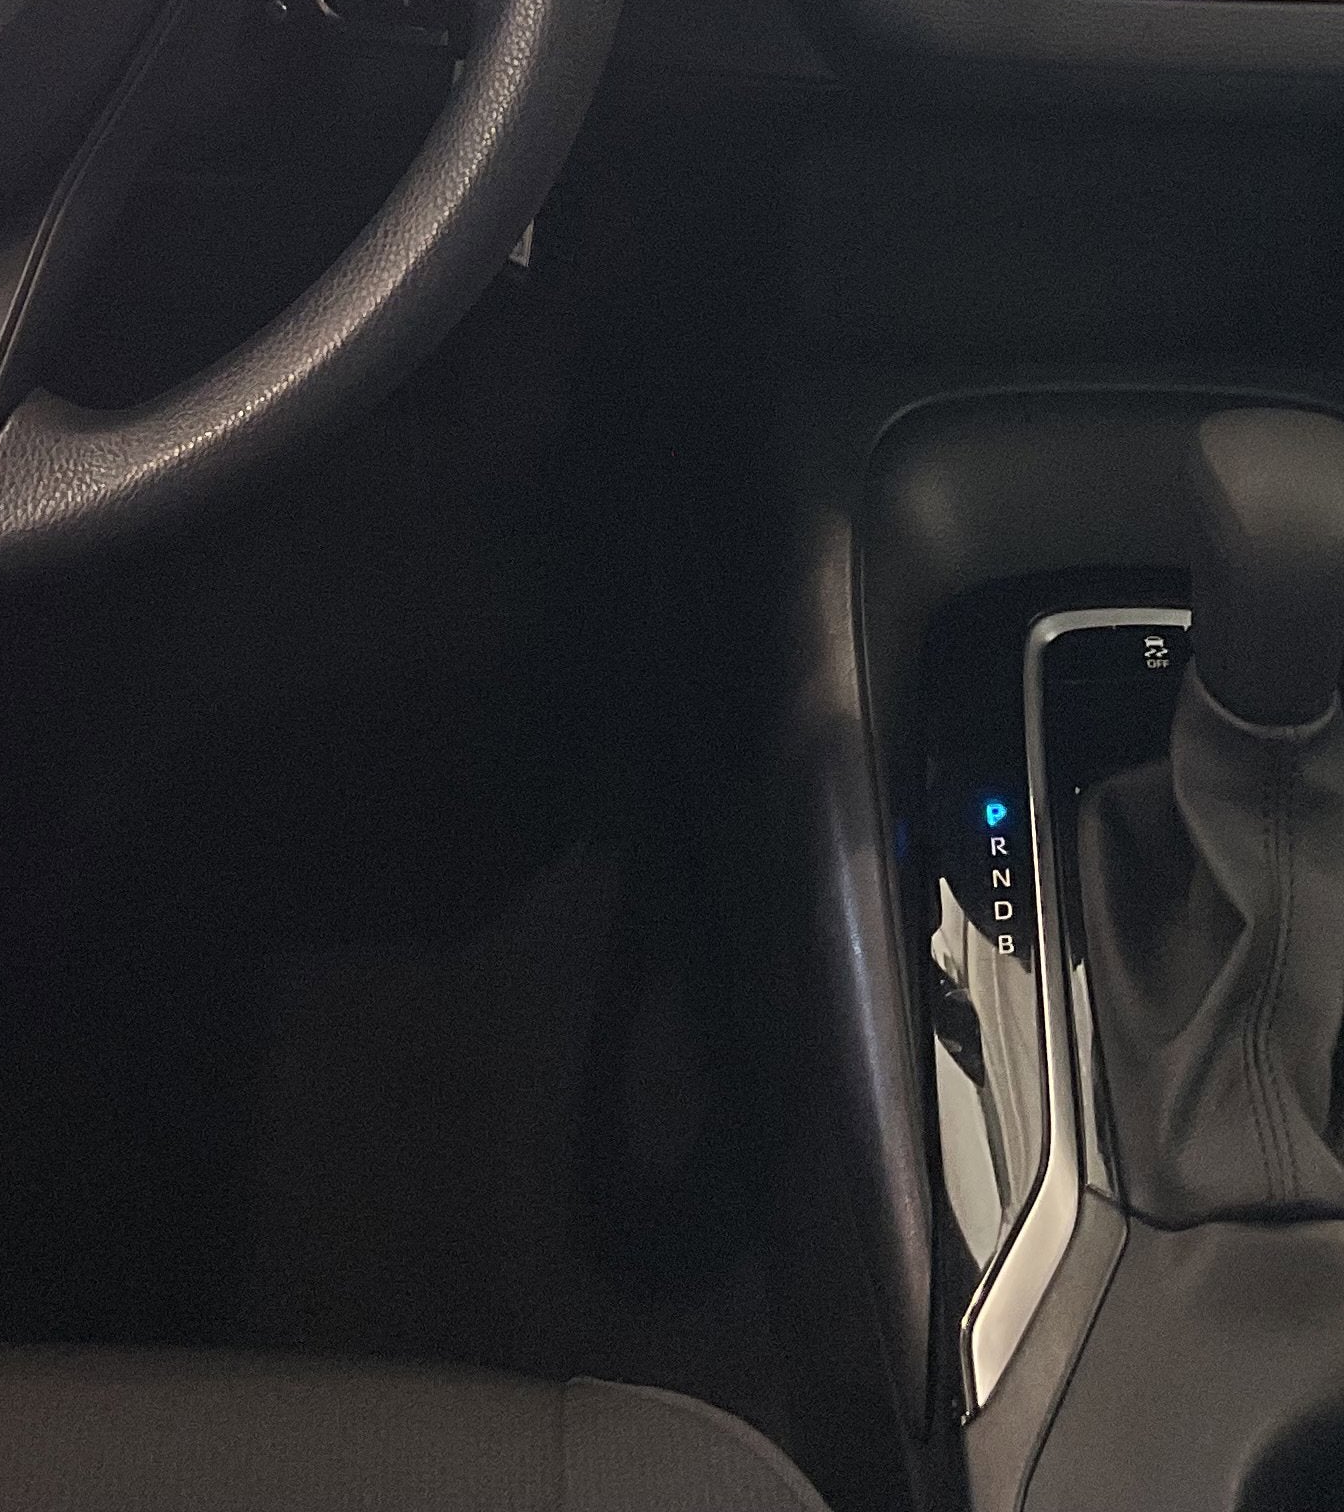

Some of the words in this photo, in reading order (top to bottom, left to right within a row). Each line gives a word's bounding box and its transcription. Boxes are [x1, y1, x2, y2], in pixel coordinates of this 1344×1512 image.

[1146, 659, 1169, 669] OFF
[986, 803, 1007, 827] P
[991, 837, 1008, 857] R
[992, 868, 1012, 888] N
[994, 901, 1014, 920] D
[998, 934, 1015, 955] B
